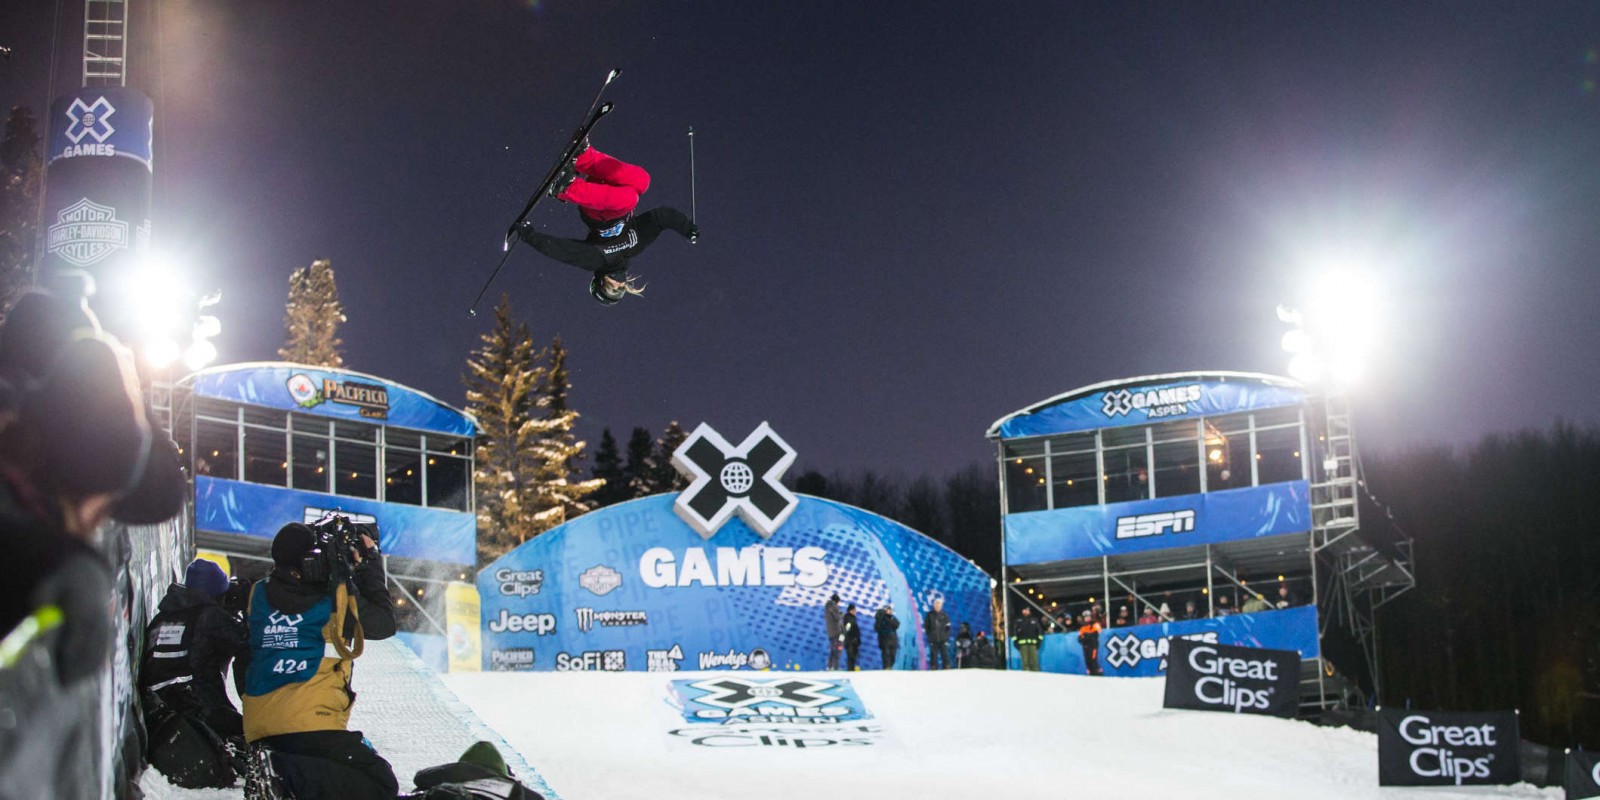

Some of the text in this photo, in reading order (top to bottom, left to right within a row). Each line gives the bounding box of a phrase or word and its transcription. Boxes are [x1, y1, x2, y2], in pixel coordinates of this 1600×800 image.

[64, 143, 115, 158] GAMES
[65, 207, 106, 223] MOTOR
[52, 225, 122, 244] HARLEY-DAVIDSON
[64, 242, 106, 259] CYCLES
[1132, 385, 1200, 409] GAMES
[1148, 404, 1188, 418] ASPEN
[1117, 510, 1195, 538] ESPN
[496, 568, 543, 582] Great
[639, 546, 829, 588] GAMES
[500, 581, 540, 598] Clips
[489, 609, 556, 635] Jeep
[593, 611, 647, 622] MONSTER
[557, 652, 601, 671] SoFi
[699, 648, 748, 669] Wendy's
[1188, 646, 1278, 680] Great
[1194, 676, 1271, 714] Clips
[694, 706, 852, 718] GAMES
[1399, 715, 1496, 746] Great
[691, 735, 874, 749] Clips
[1409, 747, 1492, 786] Clips
